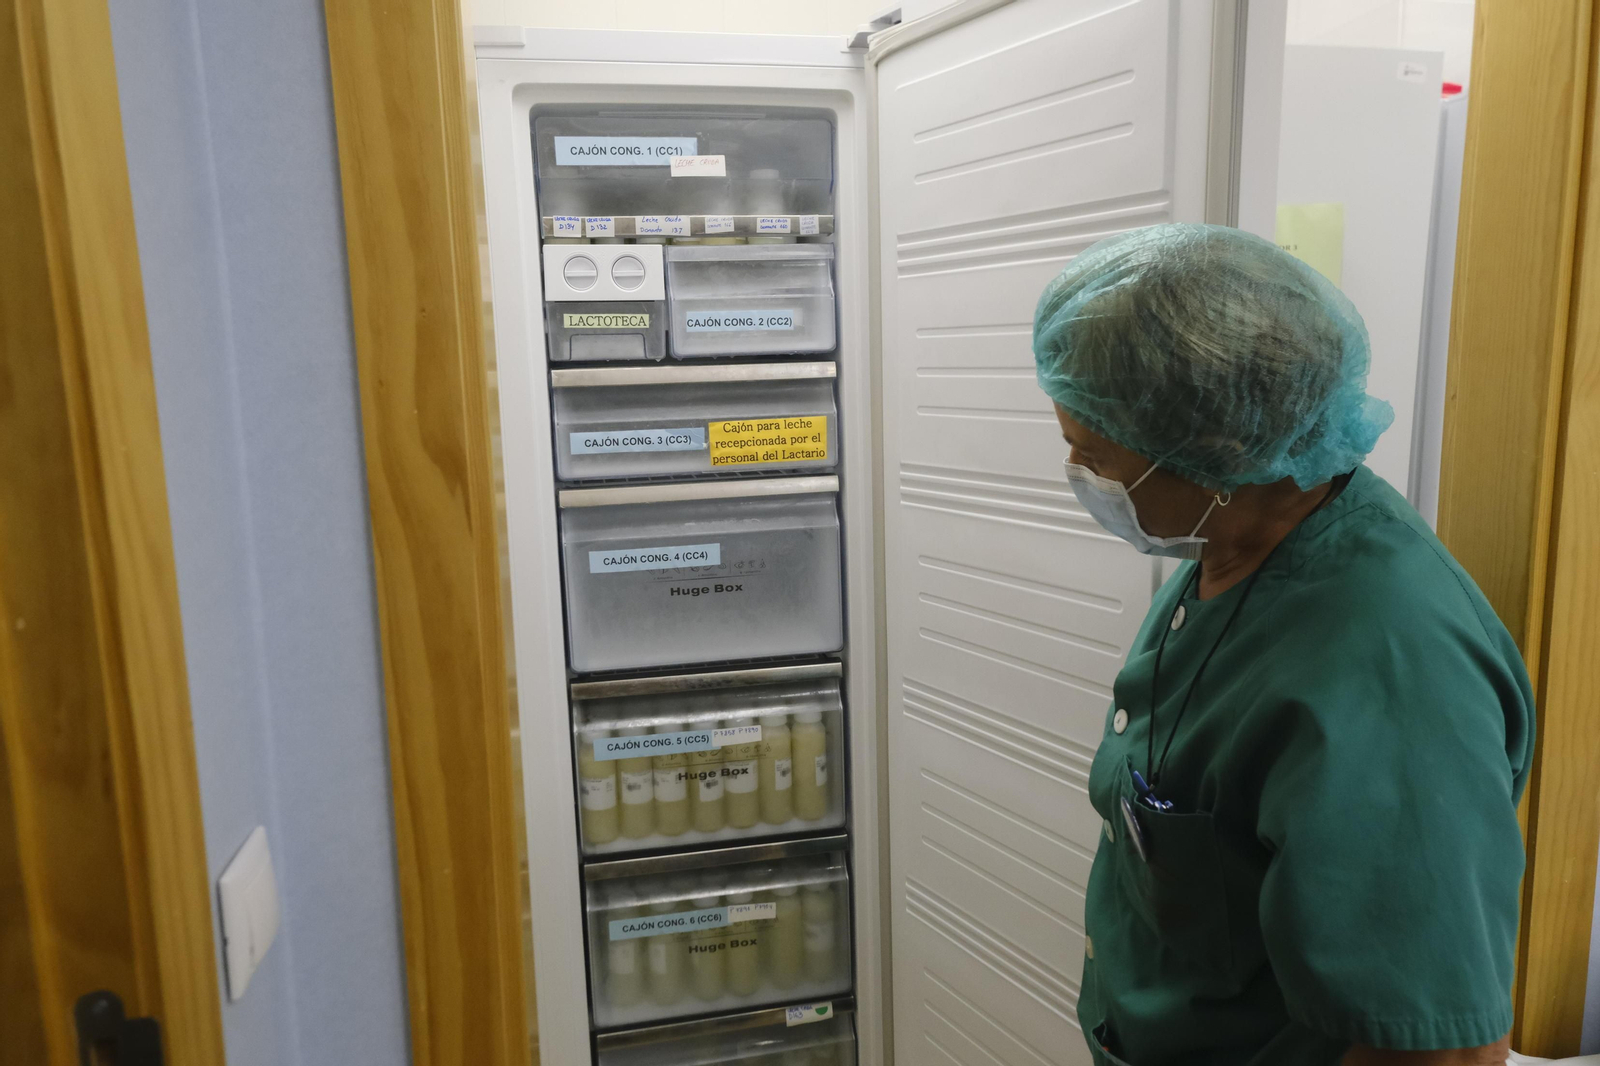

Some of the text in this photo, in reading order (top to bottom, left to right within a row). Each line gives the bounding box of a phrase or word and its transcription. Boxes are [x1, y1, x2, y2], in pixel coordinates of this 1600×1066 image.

[570, 144, 683, 157] CAJÓN CONG. 1 (CC1)
[675, 159, 694, 168] LECHE
[569, 315, 647, 327] LACTOTECA
[687, 317, 793, 328] CAJÓN CONG. 2 (CC2)
[723, 419, 813, 434] Cajón para leche
[584, 435, 692, 447] CAJÓN CONG. 3 (CC3)
[715, 433, 821, 449] recepcionada por el
[712, 448, 825, 466] personal del Lactario
[603, 551, 708, 566] CAJÓN CONG. 4 (CC4)
[670, 584, 743, 597] Huge Box
[607, 735, 710, 752] CAJÓN CONG. 5 (CC5)
[678, 769, 717, 782] Huge
[720, 766, 749, 777] Box
[622, 913, 722, 933] CAJÓN CONG. 6 (CC6)
[688, 938, 758, 954] Huge Box
